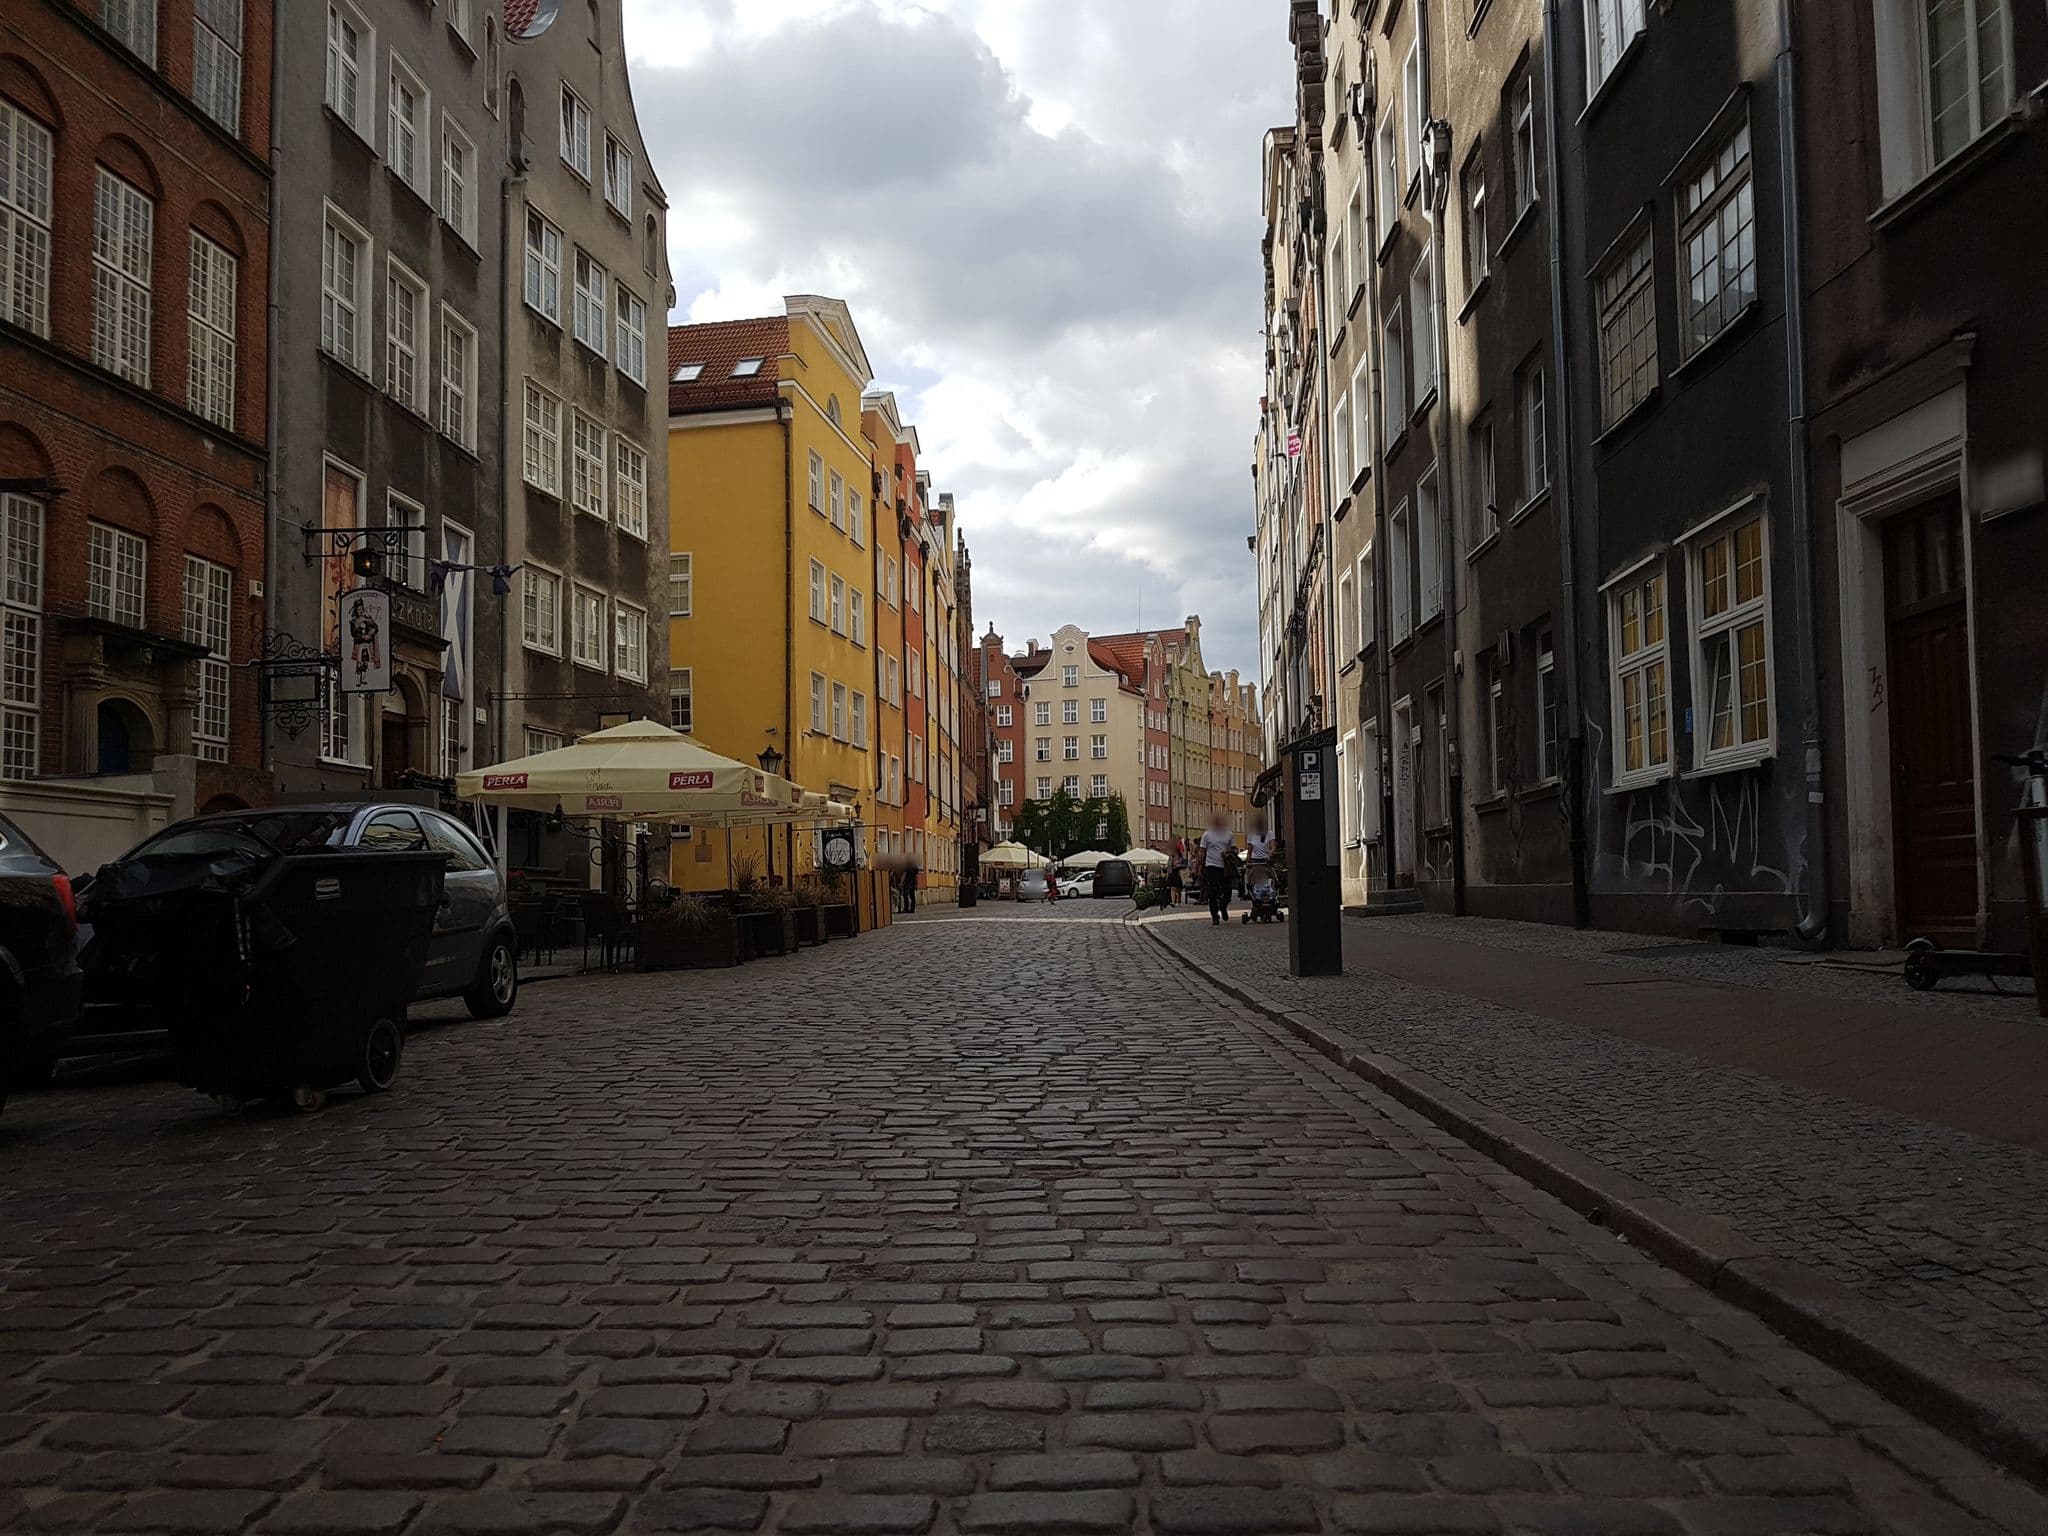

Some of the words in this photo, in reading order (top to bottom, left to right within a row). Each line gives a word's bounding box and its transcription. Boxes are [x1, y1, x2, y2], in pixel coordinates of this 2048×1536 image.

[1303, 753, 1317, 770] P
[486, 776, 524, 787] PERŁA
[672, 774, 710, 786] PERŁA
